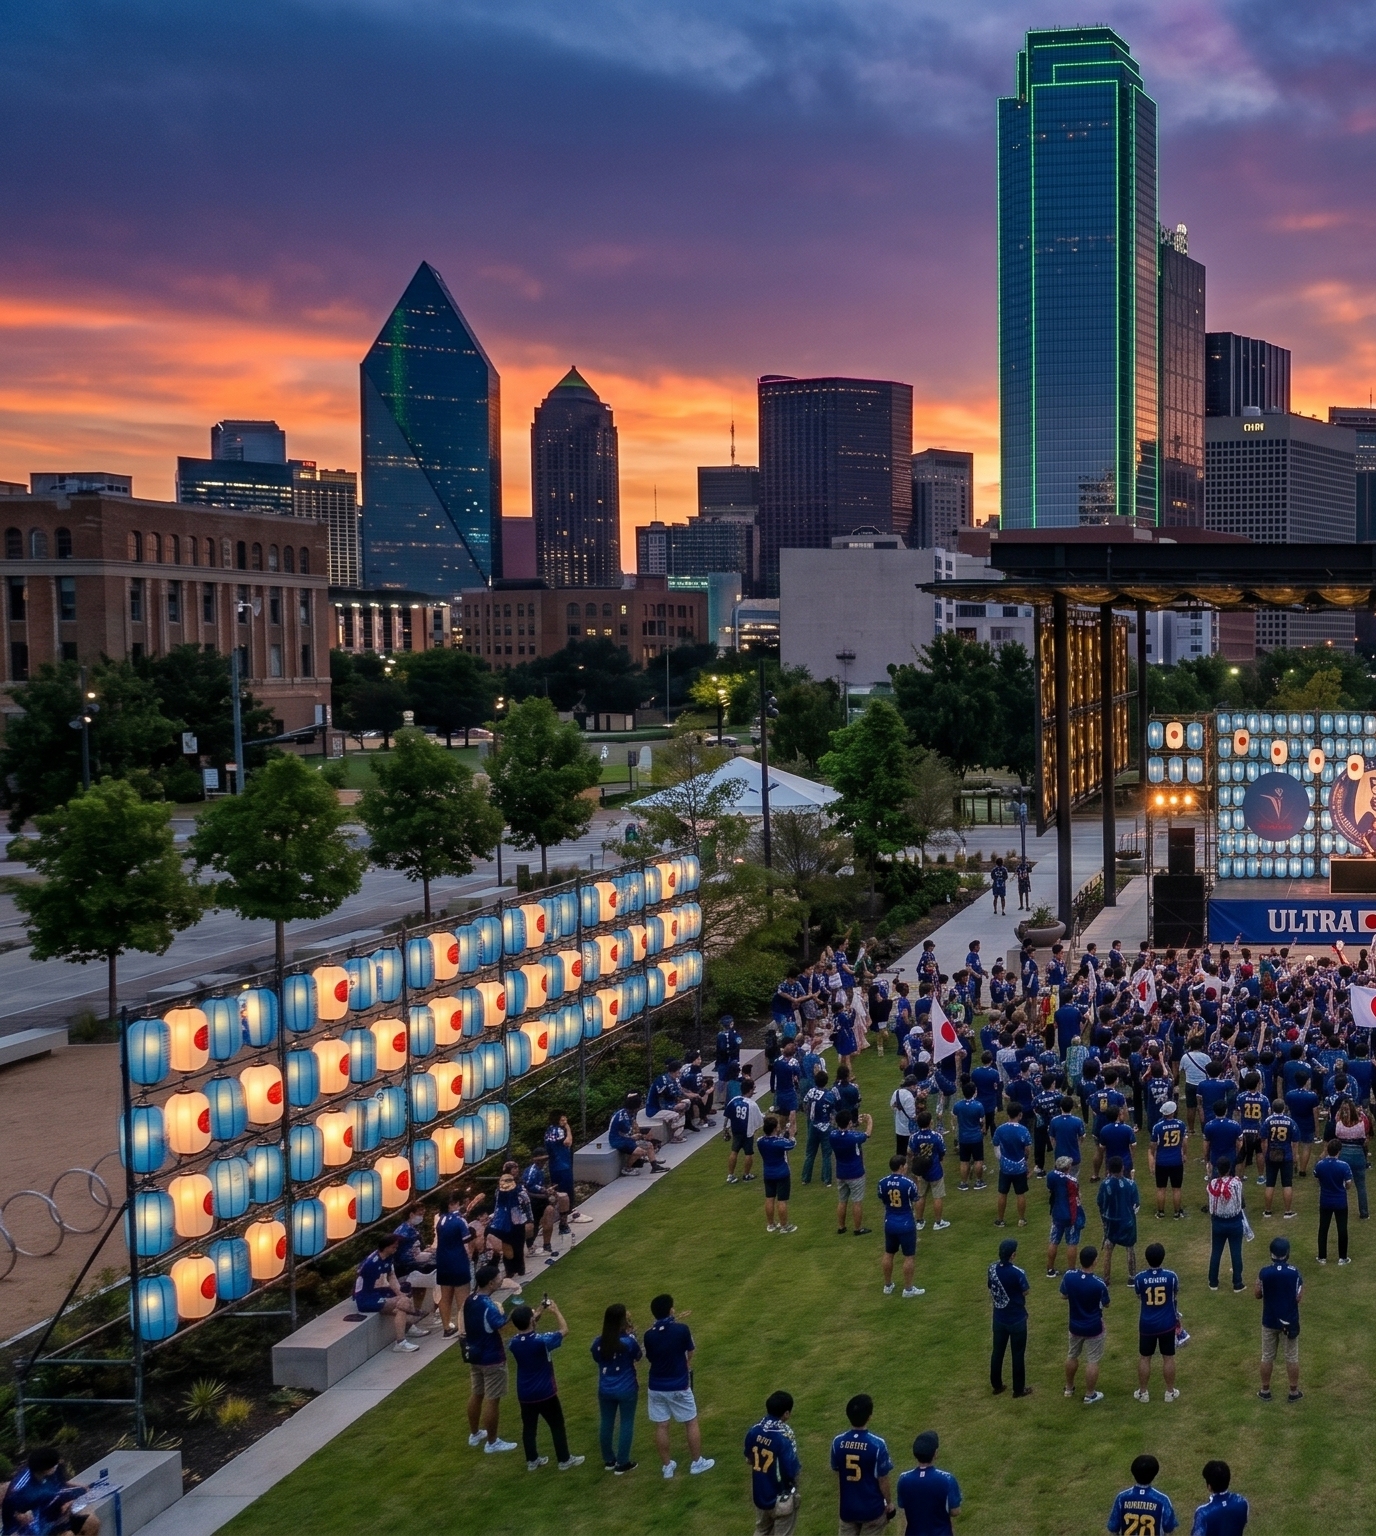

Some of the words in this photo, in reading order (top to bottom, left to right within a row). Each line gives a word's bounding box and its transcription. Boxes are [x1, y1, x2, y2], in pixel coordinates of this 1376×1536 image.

[1268, 909, 1355, 933] ULTRA
[752, 1446, 774, 1473] 17
[846, 1455, 862, 1481] 5
